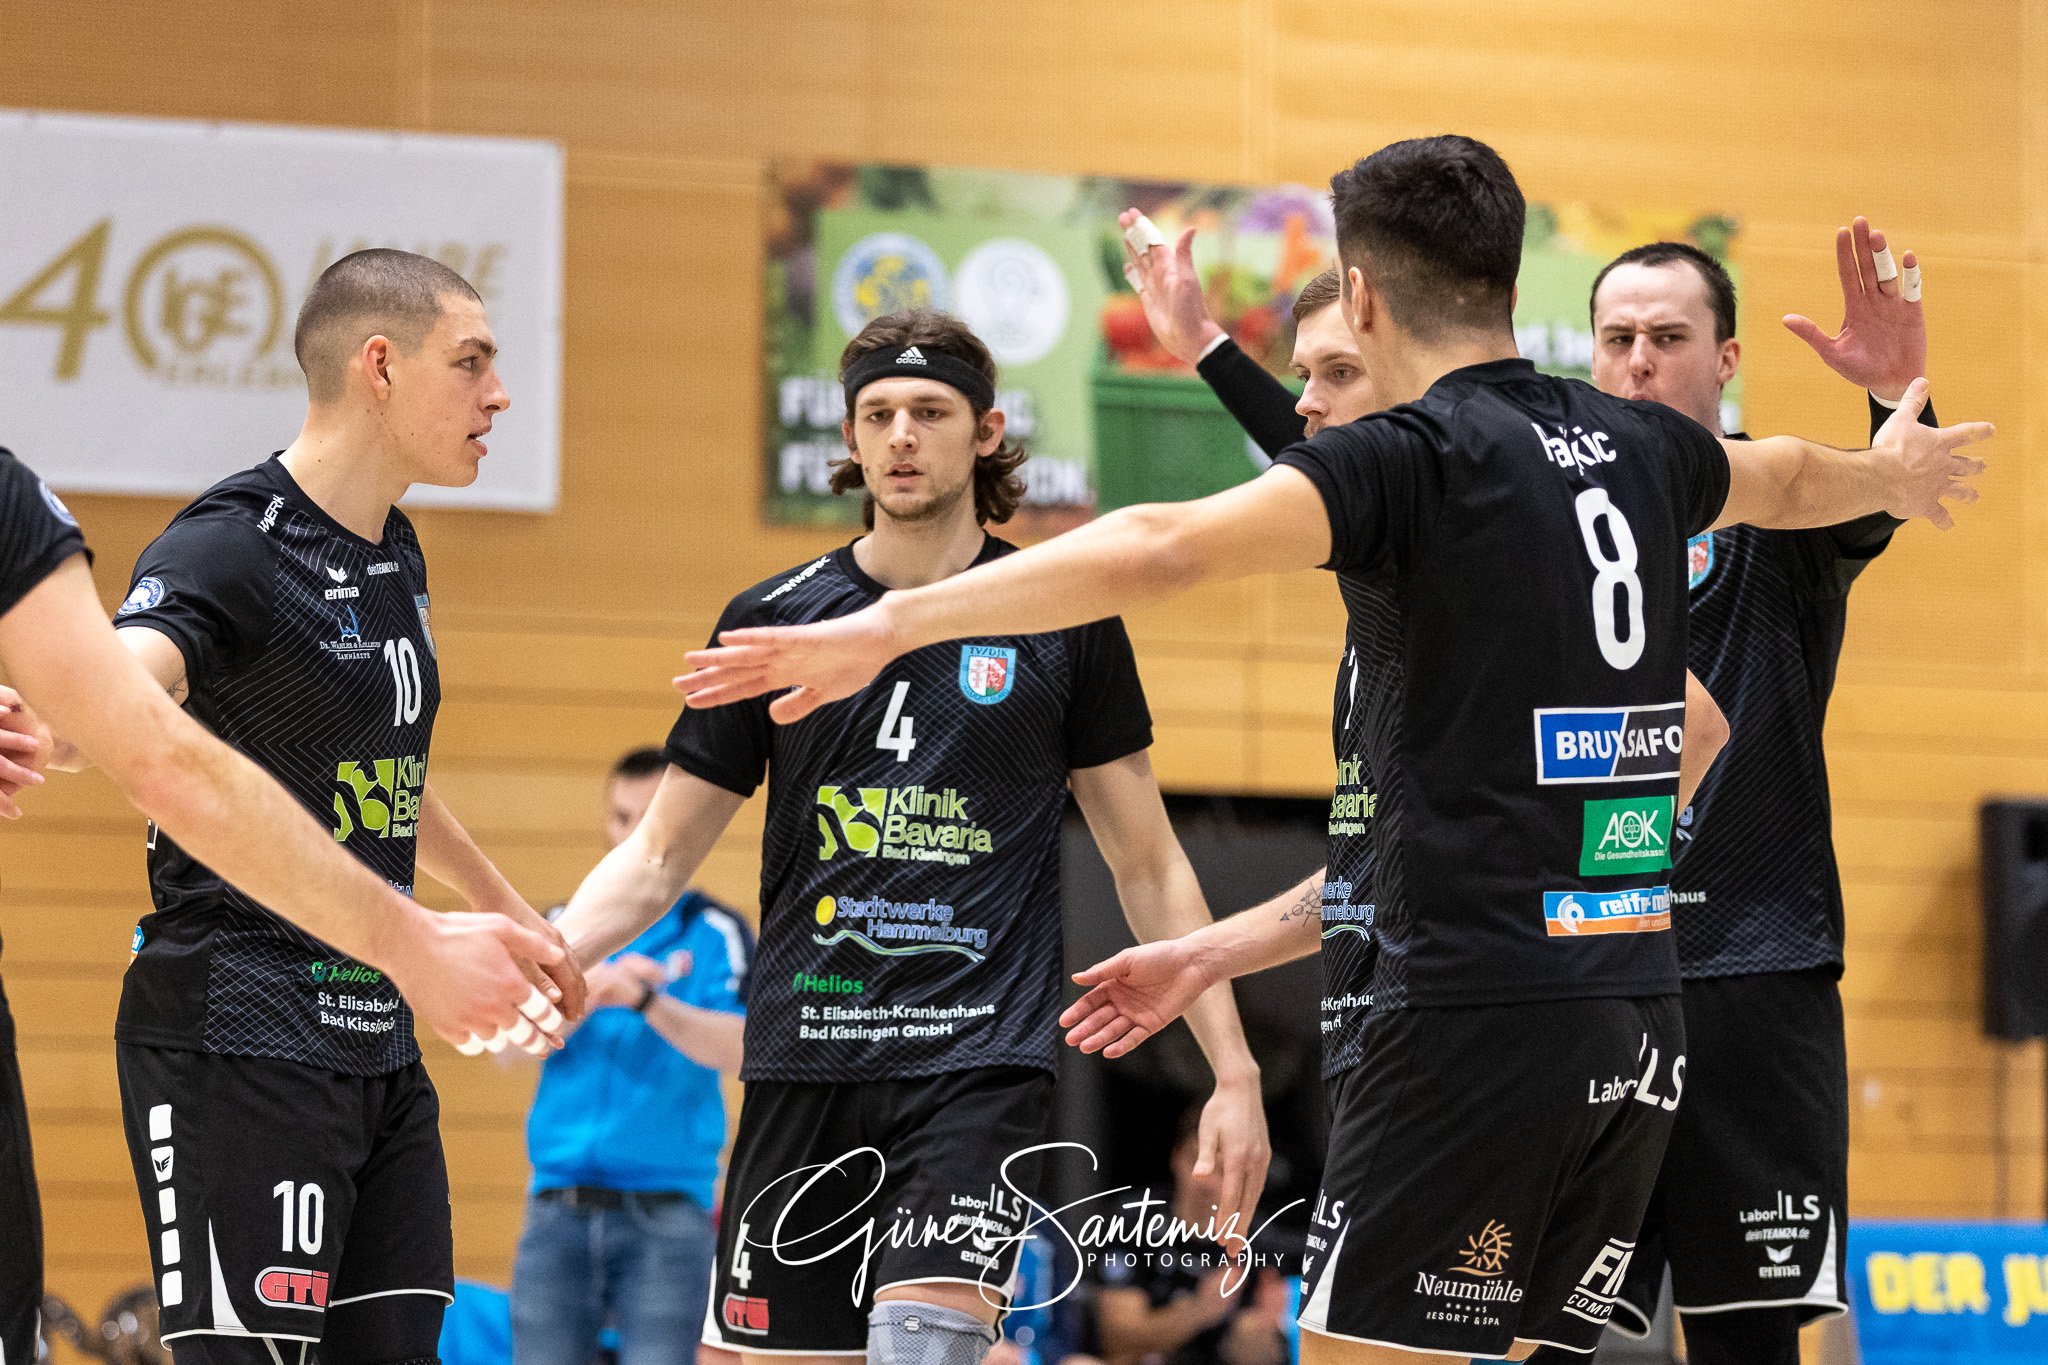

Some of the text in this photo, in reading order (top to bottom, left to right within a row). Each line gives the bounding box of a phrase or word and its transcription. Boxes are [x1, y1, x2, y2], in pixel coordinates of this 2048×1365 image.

[895, 357, 928, 366] adidas
[1574, 487, 1646, 671] 8
[324, 585, 361, 601] erima
[383, 637, 422, 727] 10
[875, 680, 917, 762] 4
[1556, 725, 1684, 760] BRUXSAFO
[396, 753, 427, 789] Klin
[887, 785, 969, 821] Klinik
[391, 822, 413, 838] Bad
[882, 814, 994, 853] Bavaria
[1597, 809, 1665, 850] AOK
[881, 845, 971, 866] Bad Kissingen
[1594, 851, 1606, 861] Die
[836, 895, 954, 921] Stadtwerke
[866, 918, 988, 949] Hammelburg
[328, 966, 381, 984] Helios
[803, 973, 864, 994] Helios
[317, 991, 336, 1008] St.
[801, 1003, 996, 1021] St. Elisabeth-Krankenhaus
[320, 1010, 345, 1028] Bad
[799, 1022, 953, 1042] Bad Kissingen GmbH
[1588, 1075, 1639, 1104] Labor
[272, 1179, 325, 1256] 10
[950, 1189, 1023, 1222] Labor LS
[1739, 1194, 1821, 1224] Labor LS
[1744, 1226, 1811, 1242] deinTEAM24.de
[730, 1222, 753, 1290] 4
[960, 1249, 1000, 1271] erima
[1758, 1264, 1802, 1279] erima
[260, 1269, 329, 1307] GTÜ
[1413, 1271, 1524, 1303] Neumühle
[1866, 1252, 2048, 1328] DER JU
[1566, 1293, 1614, 1317] COMP
[1426, 1311, 1500, 1327] RESORT & SPA
